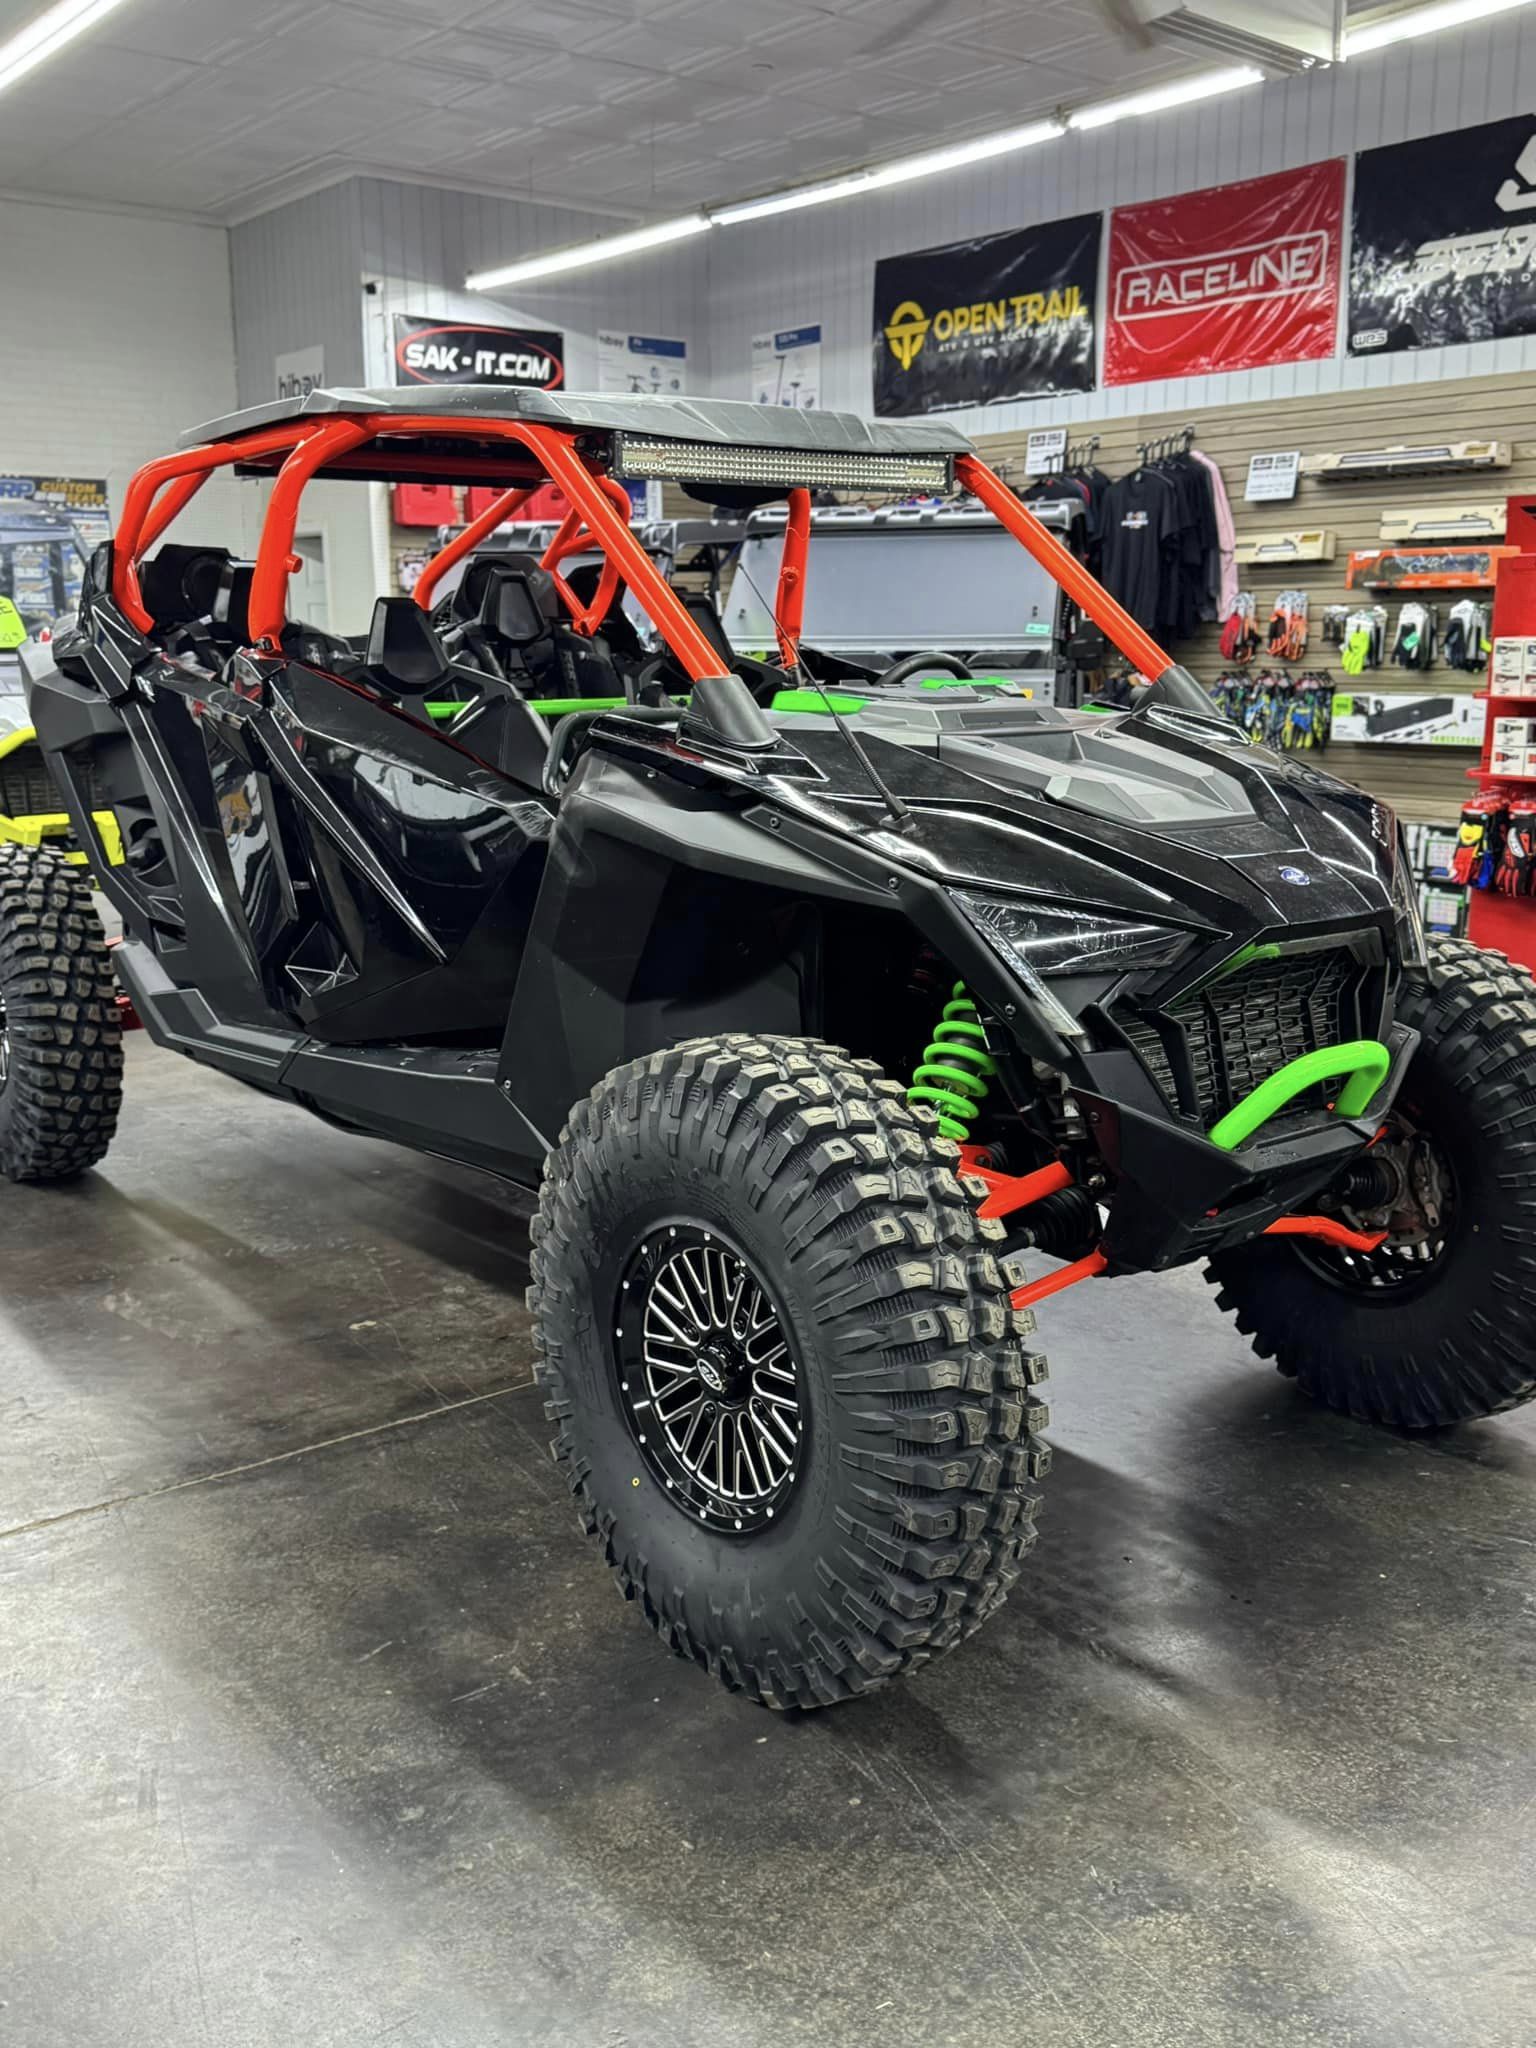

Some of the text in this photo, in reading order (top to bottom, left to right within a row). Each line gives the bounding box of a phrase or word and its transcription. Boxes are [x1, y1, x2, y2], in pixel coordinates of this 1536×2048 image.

[1126, 245, 1315, 309] RACELINE
[933, 286, 1088, 341] OPEN TRAIL
[40, 481, 97, 494] CUSTOM
